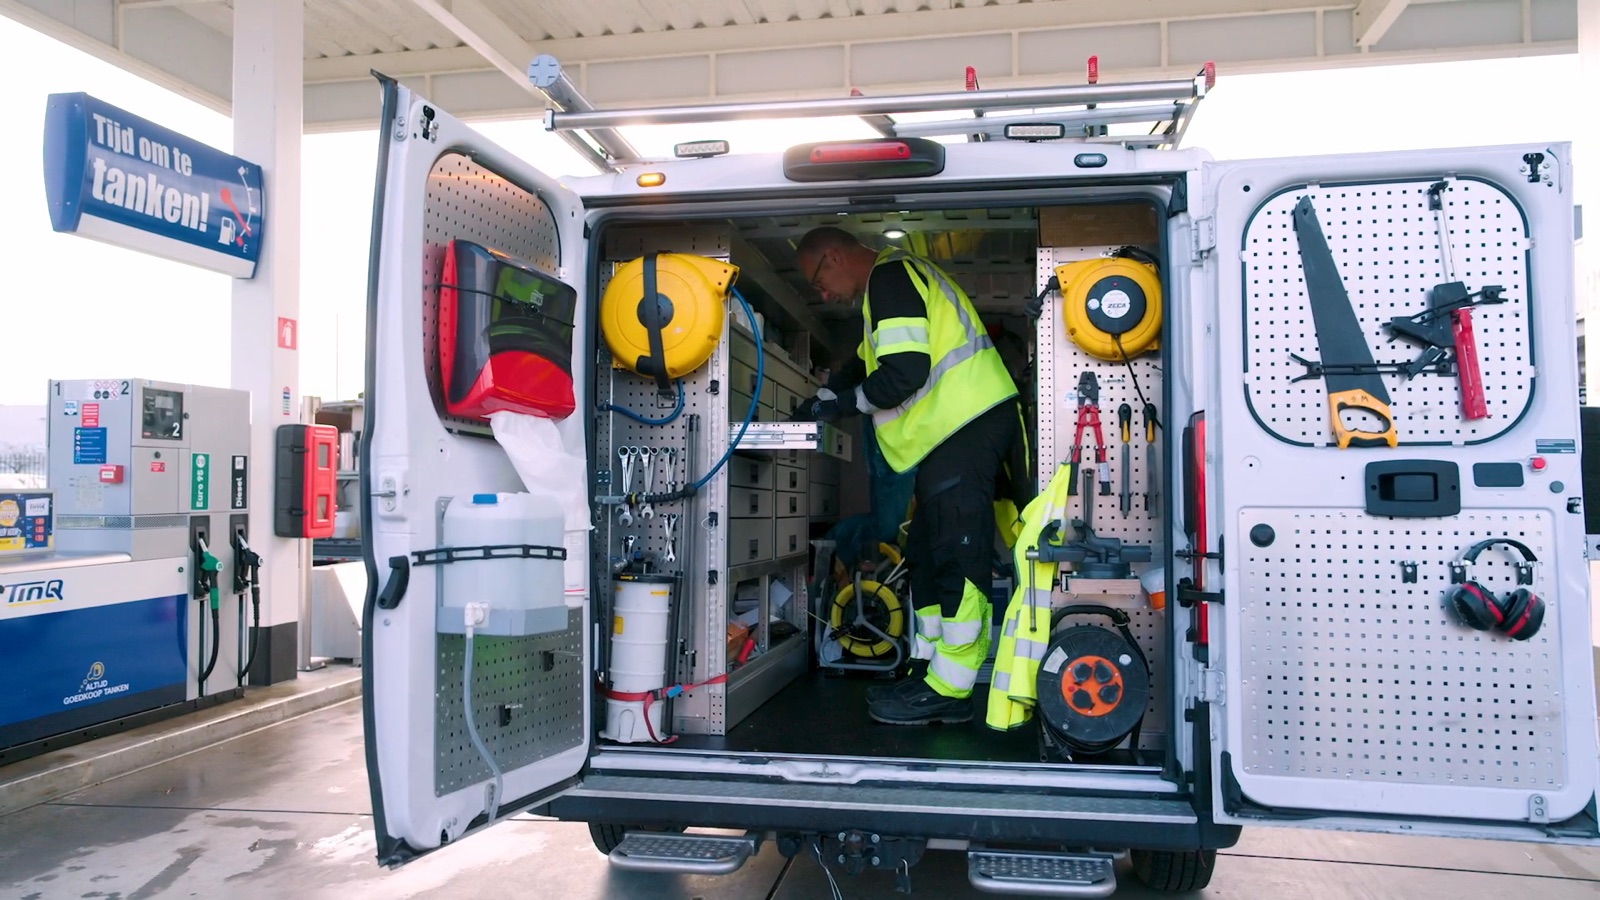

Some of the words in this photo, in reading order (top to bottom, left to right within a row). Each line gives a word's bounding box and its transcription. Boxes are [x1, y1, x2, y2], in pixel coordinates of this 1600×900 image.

[92, 113, 135, 156] Tijd
[139, 136, 170, 169] om
[173, 147, 192, 177] te
[92, 157, 210, 232] tanken!
[55, 382, 60, 396] 1
[121, 381, 129, 395] 2
[172, 422, 180, 437] 2
[196, 469, 204, 482] 95
[196, 484, 204, 508] Euro
[235, 477, 243, 507] Diesel
[4, 579, 63, 603] TinQ
[63, 689, 103, 705] GOEDKOOP
[104, 683, 129, 696] TANKEN
